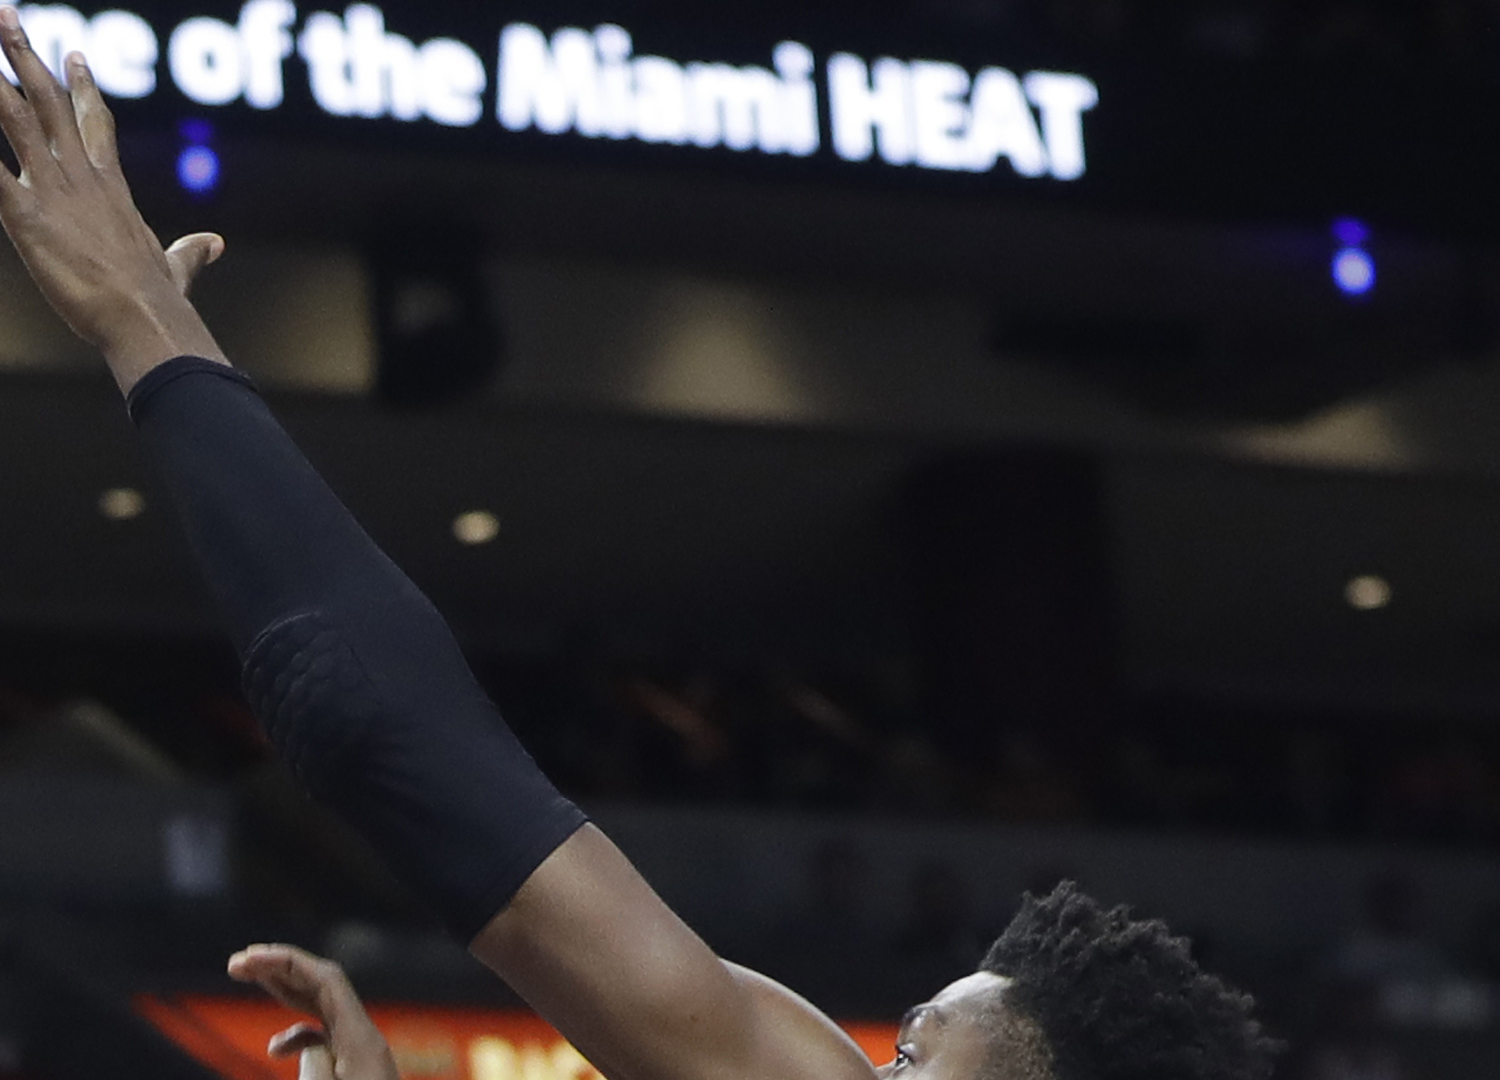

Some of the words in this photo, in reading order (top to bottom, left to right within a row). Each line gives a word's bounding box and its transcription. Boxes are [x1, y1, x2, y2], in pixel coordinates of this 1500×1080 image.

[168, 0, 296, 109] of
[297, 4, 486, 126] the
[497, 24, 819, 155] Miami
[828, 53, 1098, 180] HEAT
